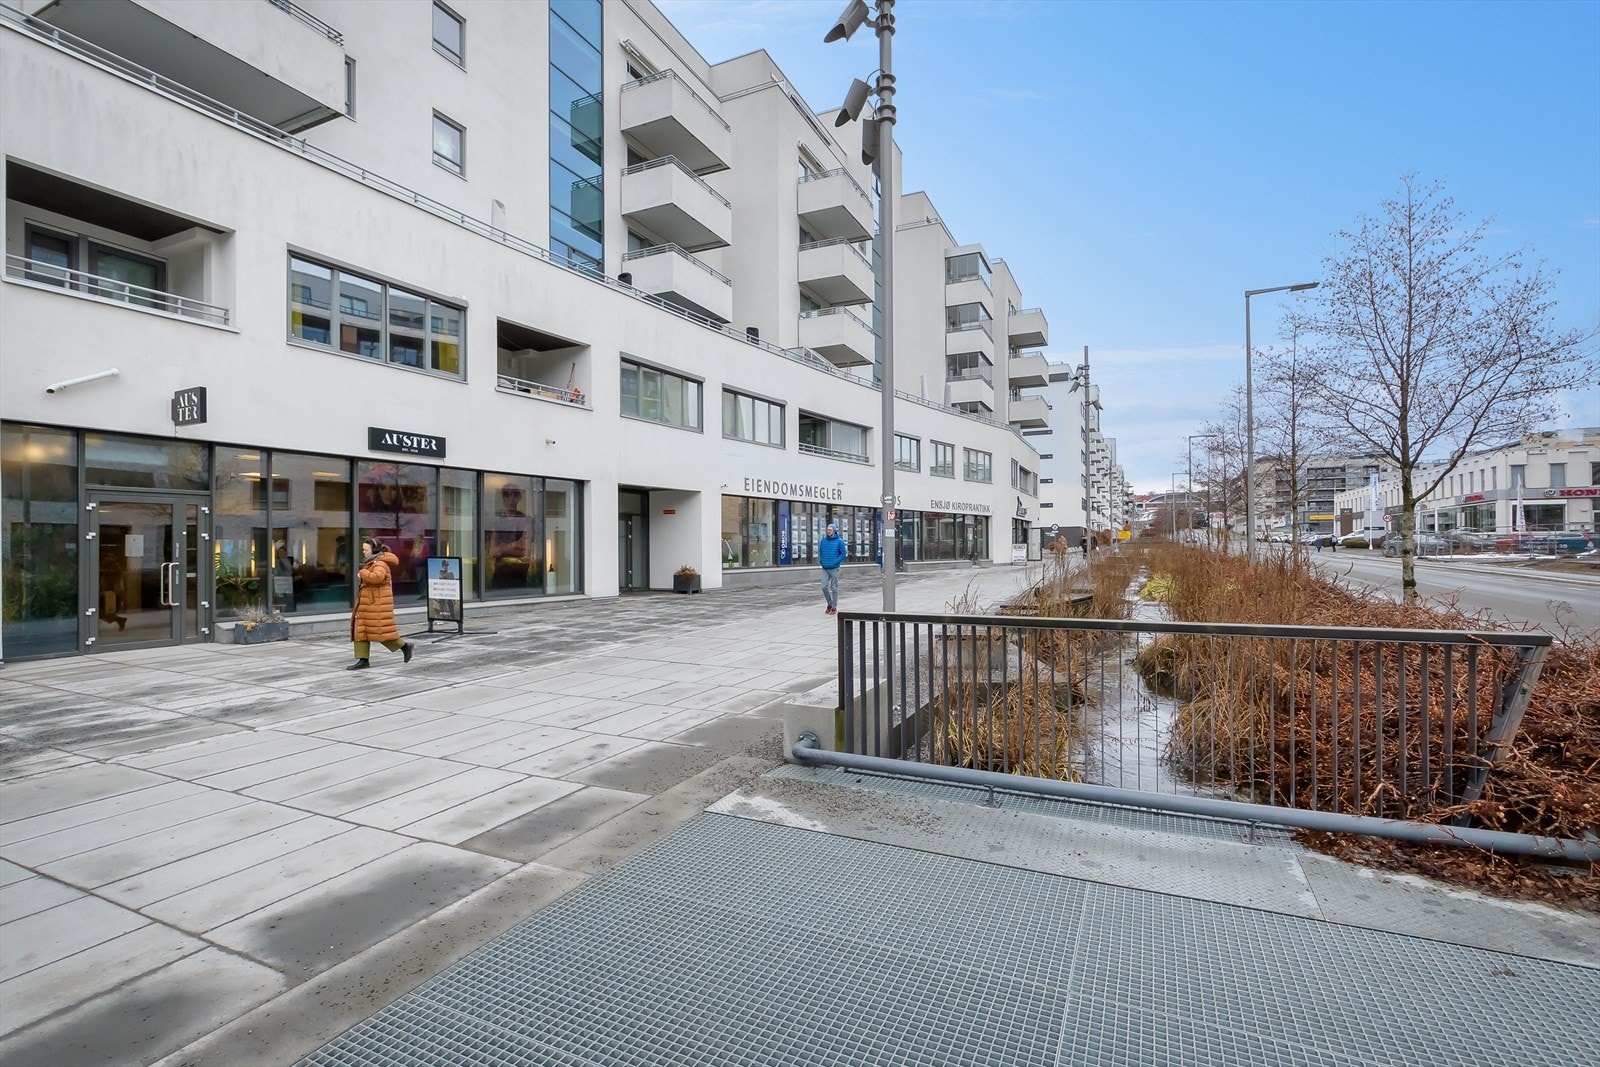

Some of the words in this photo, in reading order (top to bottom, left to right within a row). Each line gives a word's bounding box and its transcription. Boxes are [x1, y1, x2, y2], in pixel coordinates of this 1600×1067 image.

[177, 391, 198, 408] AUS
[177, 405, 198, 422] TER
[381, 432, 438, 451] AUSTER
[744, 477, 842, 501] EIENDOMSMEGLER
[1559, 489, 1600, 497] HON
[930, 499, 950, 510] ENSJØ
[951, 501, 991, 513] KIROPRAKTIKK
